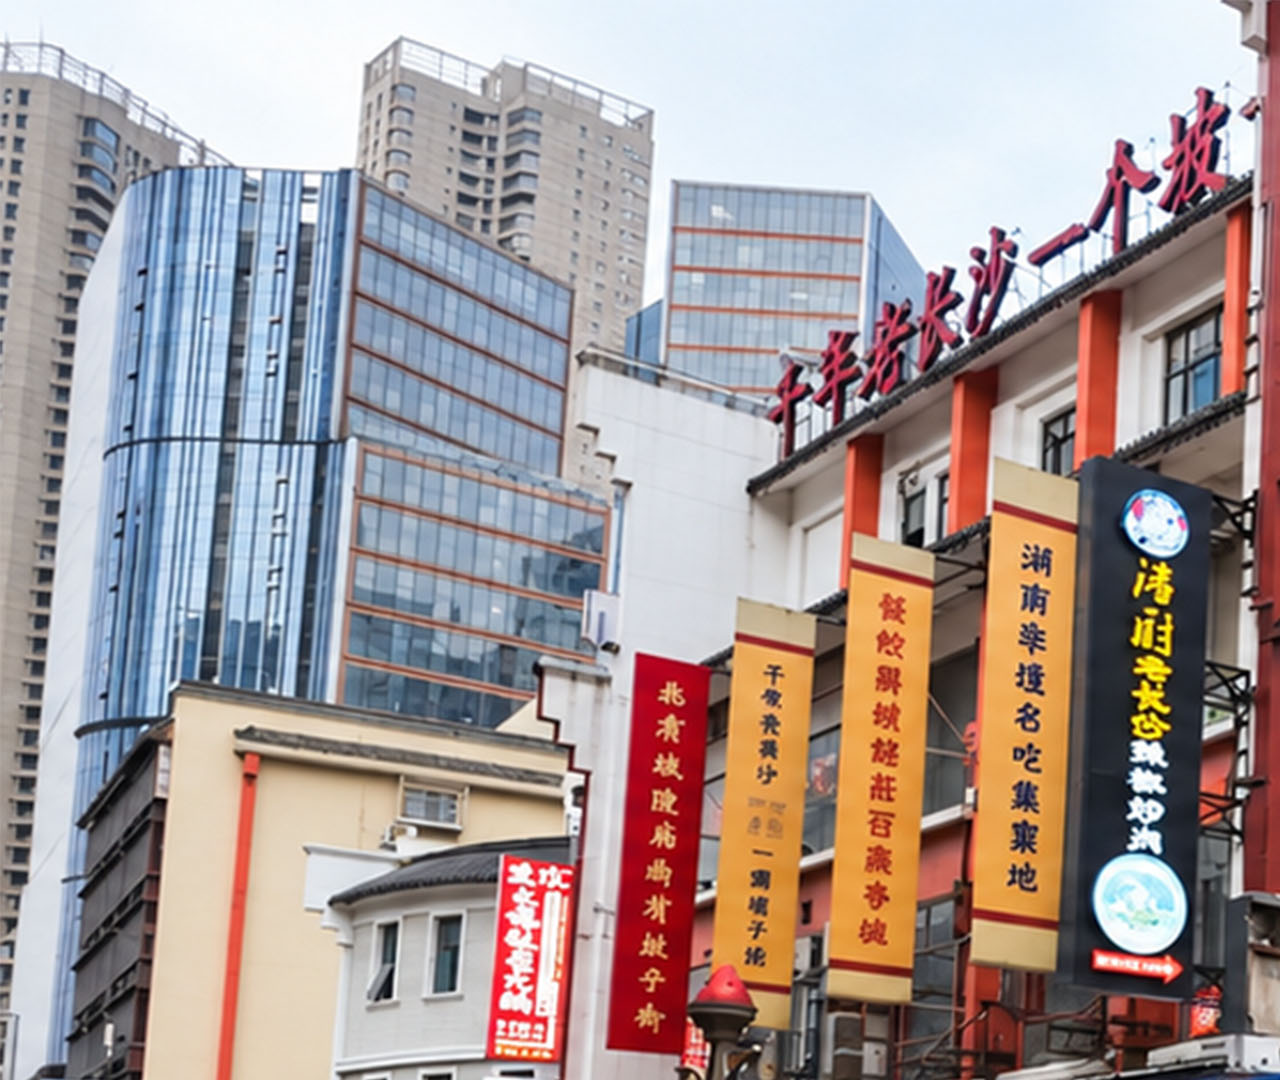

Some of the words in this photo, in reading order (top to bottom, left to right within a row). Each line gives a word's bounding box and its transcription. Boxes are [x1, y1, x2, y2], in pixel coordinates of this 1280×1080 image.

[766, 87, 1262, 459] 千年老长沙一个坡
